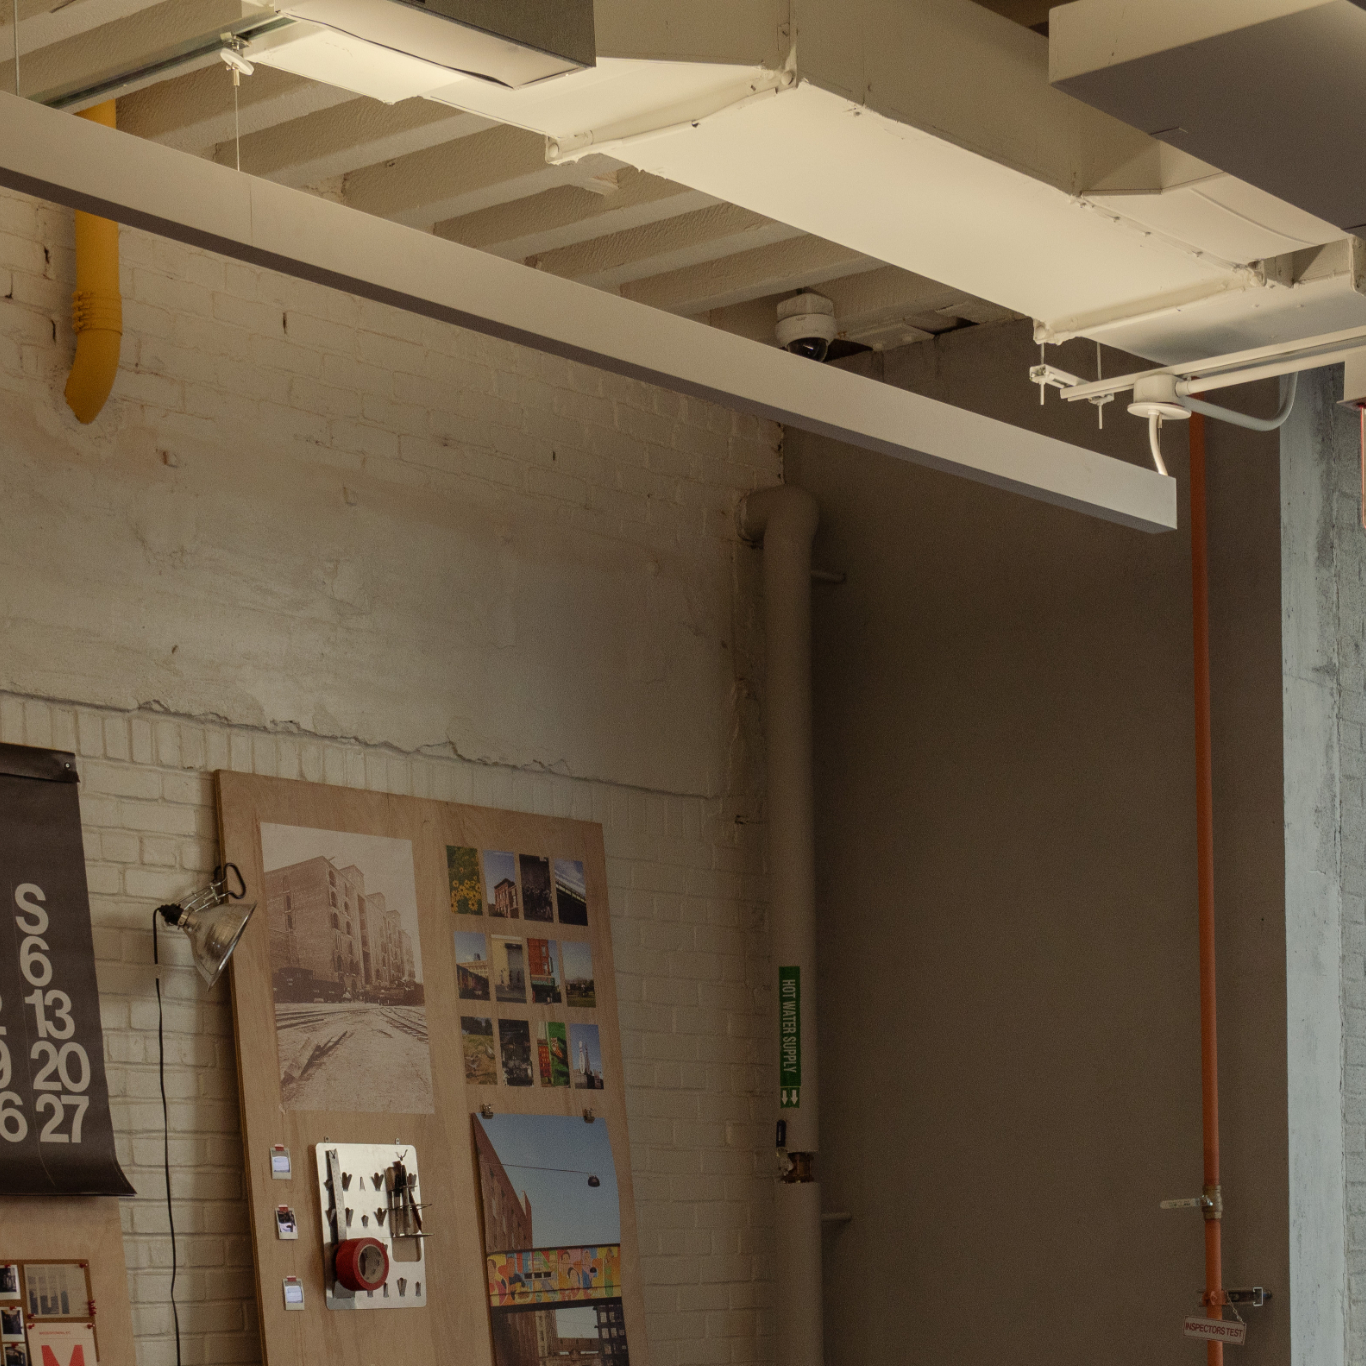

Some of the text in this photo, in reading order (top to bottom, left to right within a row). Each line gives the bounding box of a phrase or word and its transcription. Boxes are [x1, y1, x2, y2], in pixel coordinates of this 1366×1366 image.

[14, 882, 50, 936] S
[18, 935, 54, 988] 6
[23, 988, 76, 1041] 13
[781, 979, 797, 1074] HOT WATER SUPPLY
[29, 1039, 92, 1094] 20
[35, 1092, 90, 1144] 27
[1185, 1321, 1243, 1338] INSPECTORS TEST
